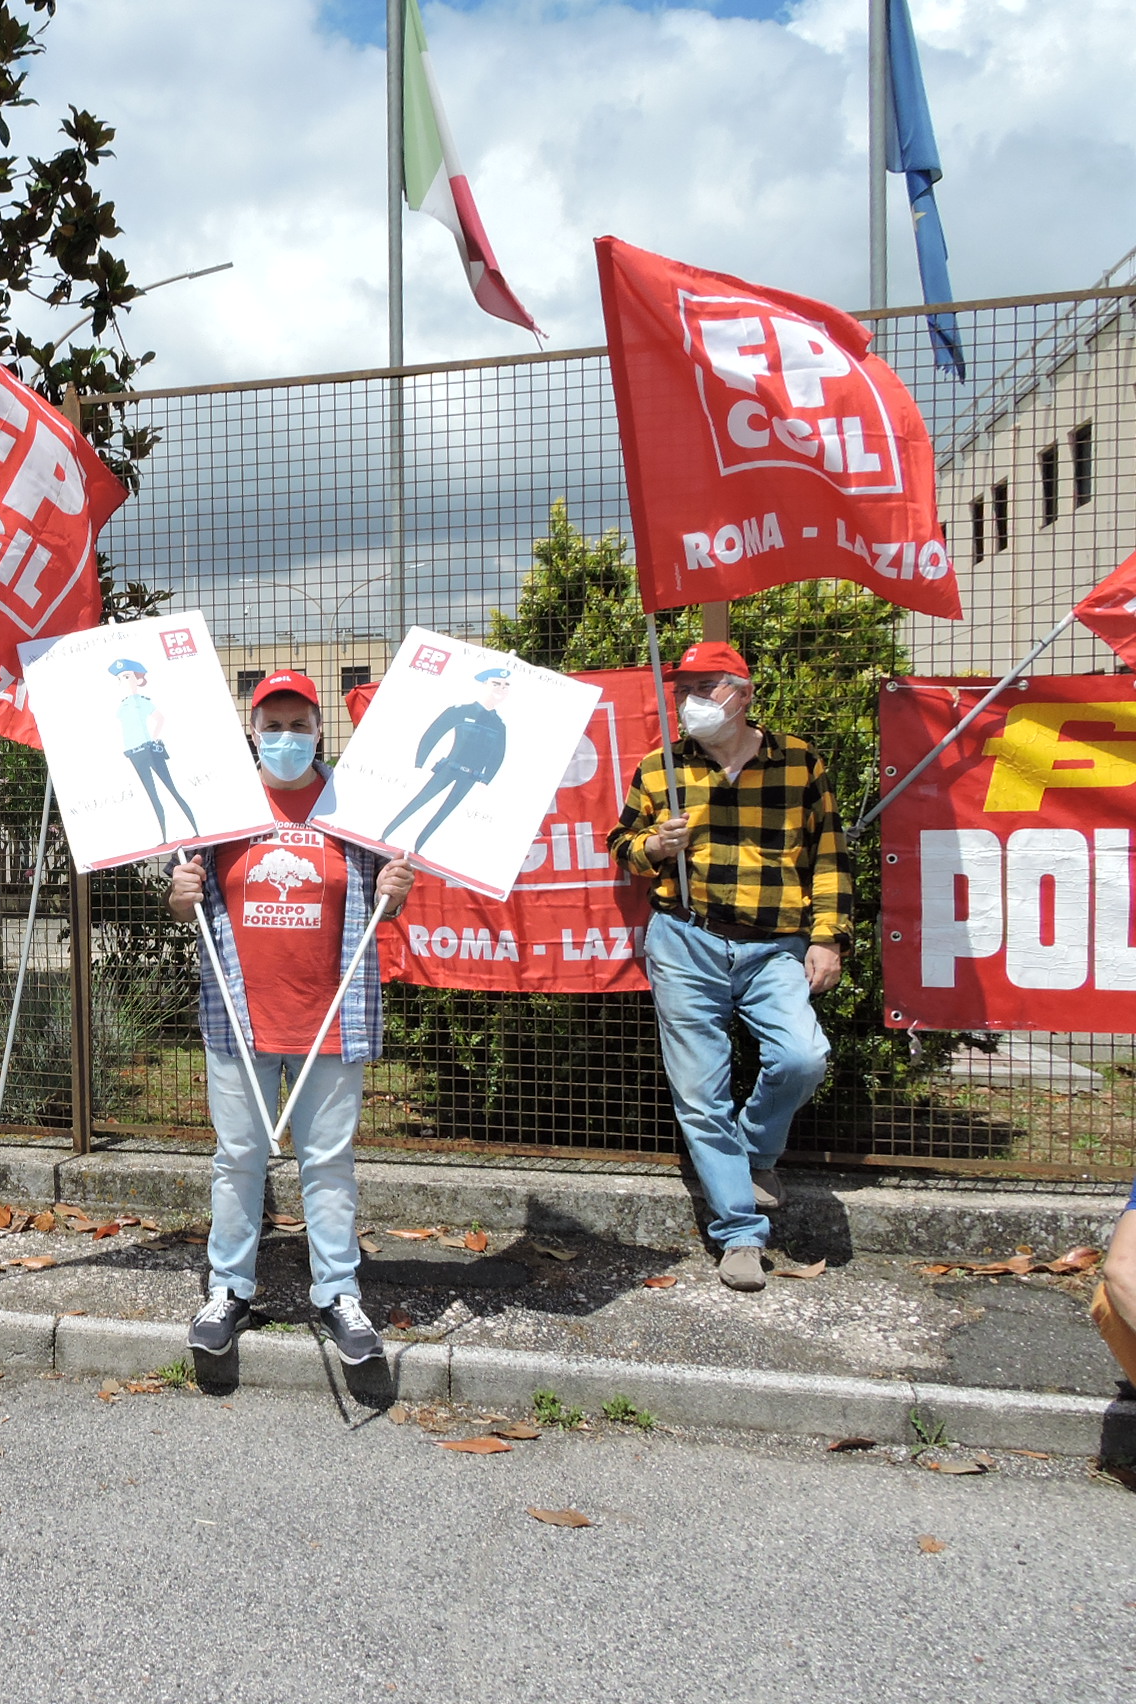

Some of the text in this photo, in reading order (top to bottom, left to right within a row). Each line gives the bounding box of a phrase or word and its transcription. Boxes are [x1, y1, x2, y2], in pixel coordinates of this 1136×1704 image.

[699, 315, 851, 408] FP
[727, 399, 882, 474] CGIL
[682, 512, 784, 571] ROMA
[836, 518, 949, 580] LAZIO
[164, 631, 189, 648] FP
[418, 648, 446, 663] FP
[280, 832, 320, 845] CGIL
[255, 905, 305, 915] CORPO
[244, 915, 320, 926] FORESTALE
[408, 925, 519, 962] ROMA
[562, 926, 646, 961] LAZI
